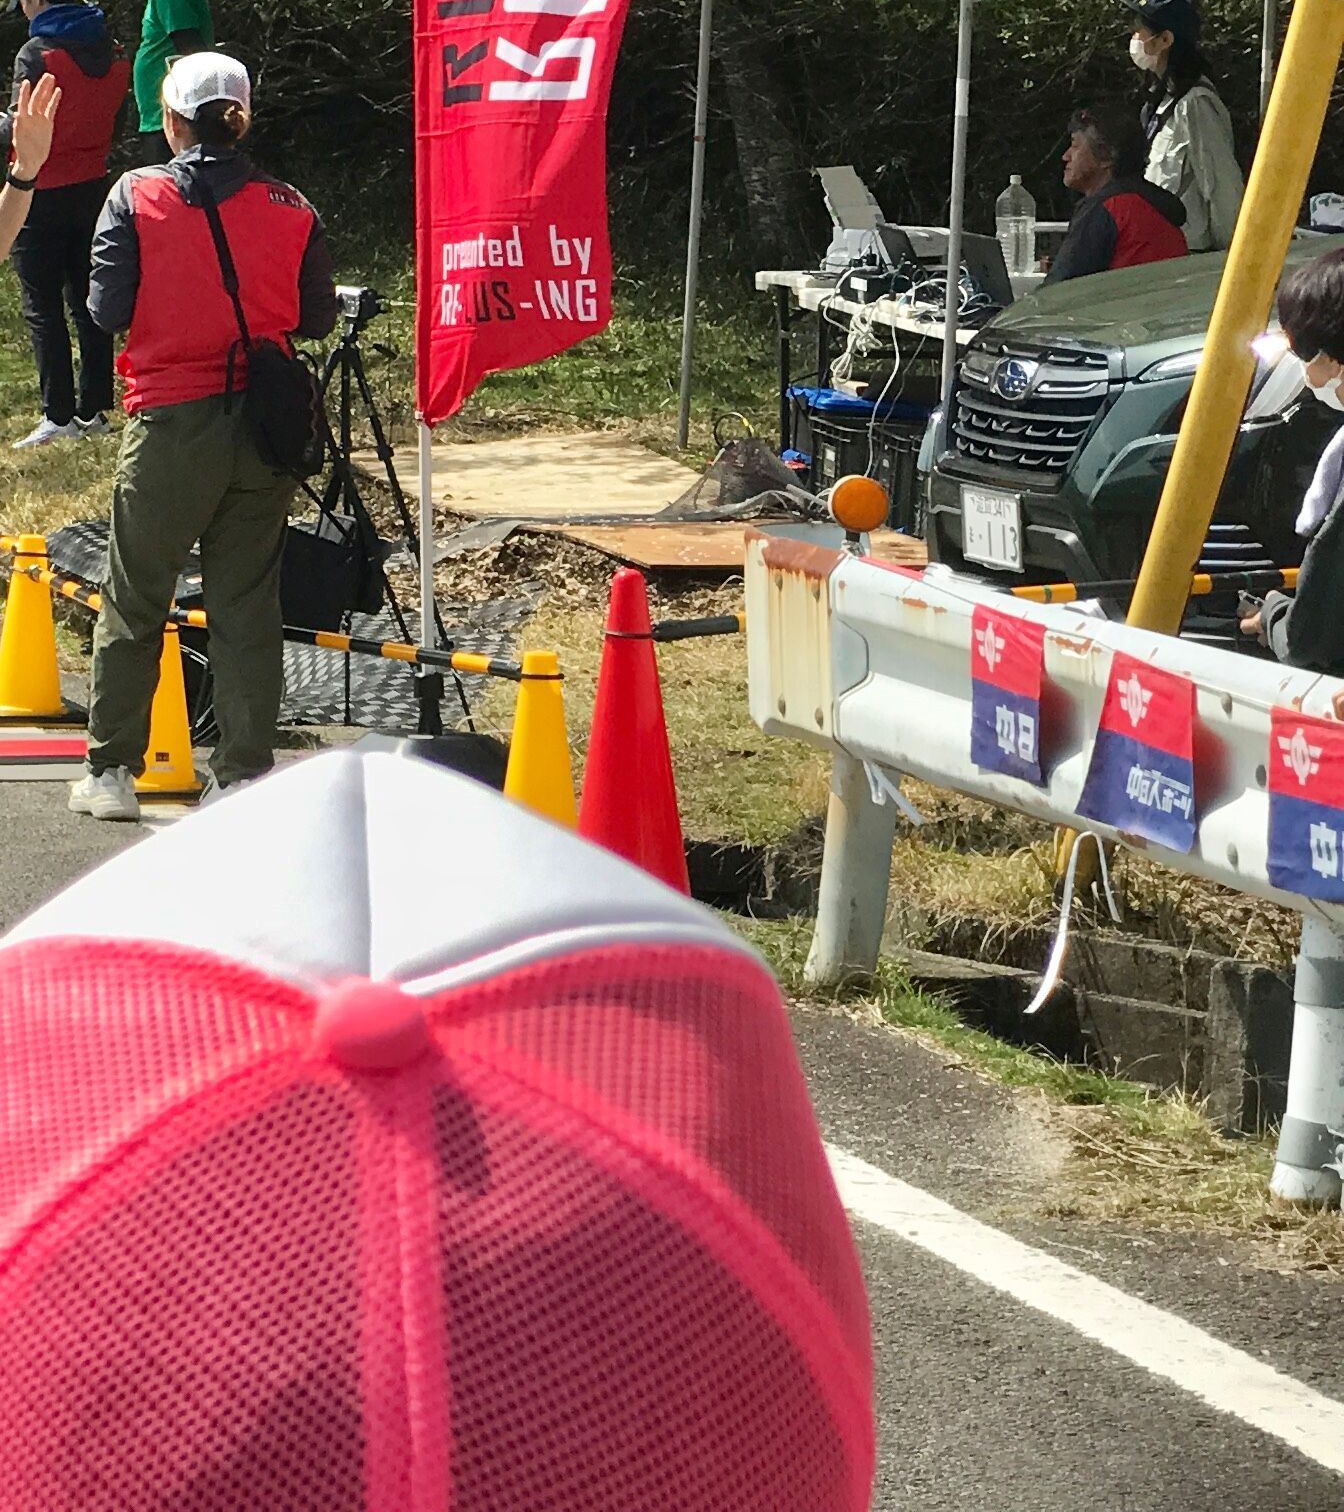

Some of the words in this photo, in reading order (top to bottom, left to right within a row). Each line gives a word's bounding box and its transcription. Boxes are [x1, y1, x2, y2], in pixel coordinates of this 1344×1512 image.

[549, 224, 592, 275] by
[995, 704, 1035, 764] 中日
[1310, 821, 1344, 880] 中
